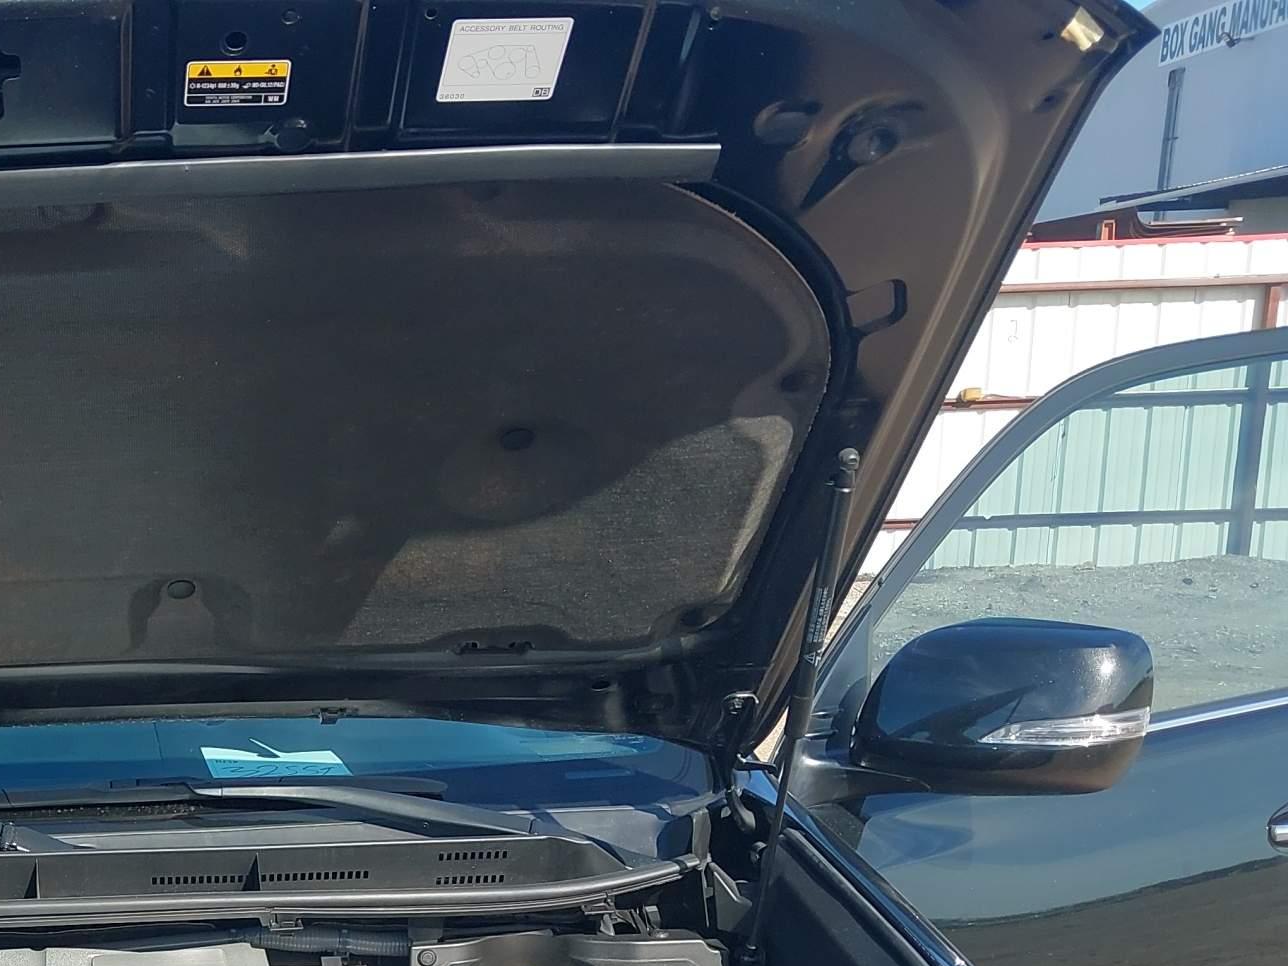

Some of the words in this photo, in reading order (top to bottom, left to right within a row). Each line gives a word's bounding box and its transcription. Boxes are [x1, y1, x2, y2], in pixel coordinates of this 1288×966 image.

[530, 23, 565, 31] ROUTING
[1160, 20, 1189, 63] BOX
[1189, 6, 1228, 52] GANG
[1230, 0, 1288, 36] MANUFA
